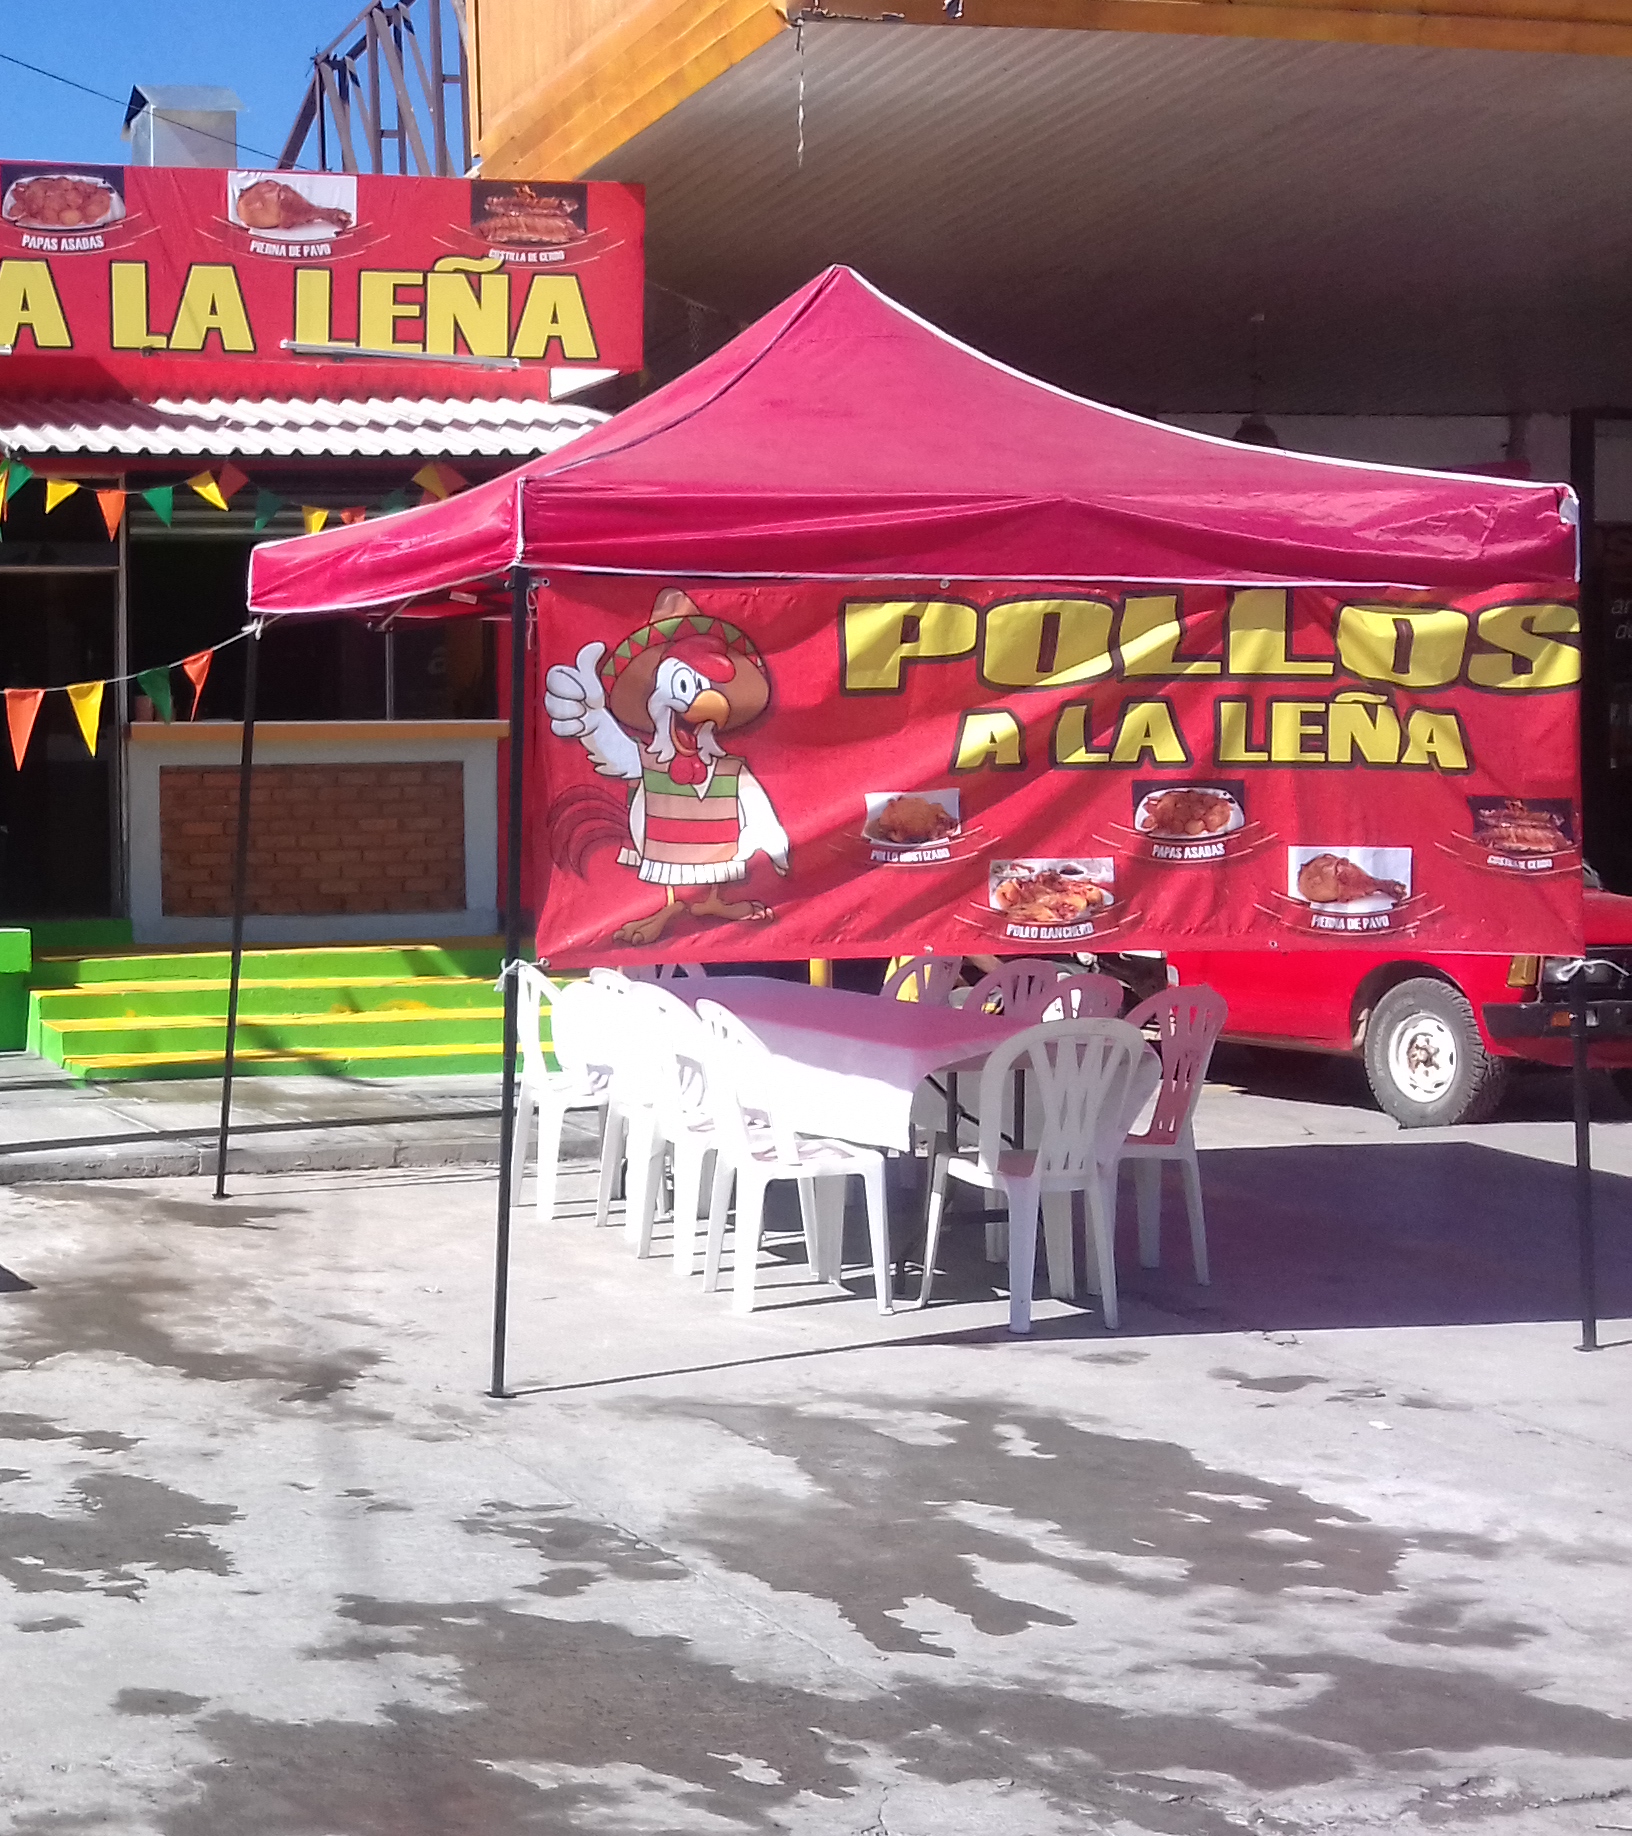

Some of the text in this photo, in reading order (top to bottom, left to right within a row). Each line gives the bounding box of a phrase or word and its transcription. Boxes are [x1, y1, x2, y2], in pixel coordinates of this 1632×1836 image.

[21, 232, 105, 251] PAPAS ASADAS
[288, 244, 302, 258] DE
[302, 242, 332, 257] PAVO
[107, 258, 257, 352] LA
[293, 253, 599, 360] LEÑA
[837, 586, 1583, 697] POLLOS
[951, 689, 1474, 773] A LA LEÑA
[1151, 842, 1226, 859] PAPAS ASADAS
